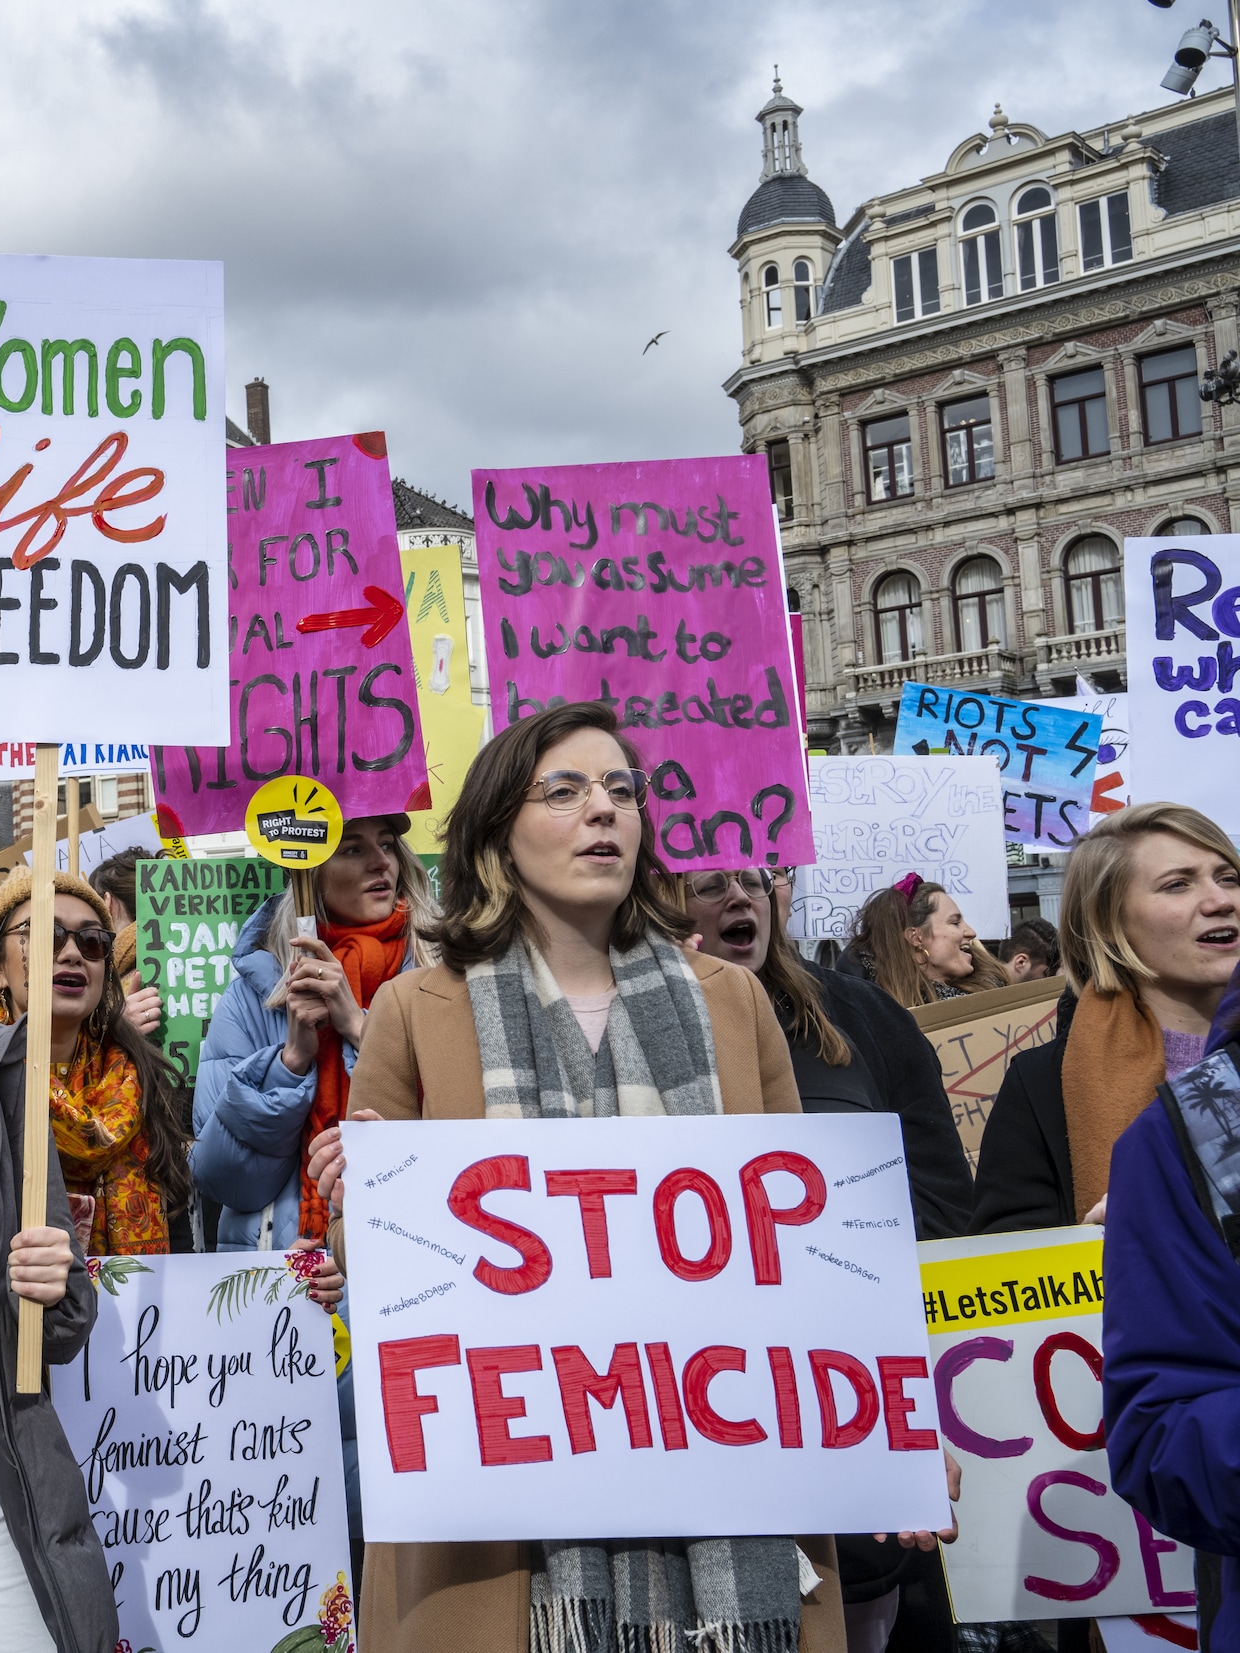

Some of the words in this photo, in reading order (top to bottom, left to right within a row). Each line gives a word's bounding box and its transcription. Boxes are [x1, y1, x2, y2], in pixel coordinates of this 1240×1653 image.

[226, 466, 267, 514] EN
[304, 457, 343, 509] I
[485, 481, 599, 550] Why
[609, 494, 744, 547] must
[259, 528, 359, 587] FOR
[497, 546, 586, 597] you
[590, 551, 767, 594] assume
[229, 611, 294, 656] AL
[500, 617, 520, 660] I
[530, 615, 667, 662] want
[675, 619, 732, 664] to
[155, 663, 415, 796] IGHTS
[507, 681, 568, 725] b
[916, 687, 1040, 741] RIOTS
[651, 759, 697, 801] a
[943, 729, 1049, 783] NOT
[262, 816, 292, 829] RIGHT
[268, 829, 279, 837] TO
[281, 826, 326, 838] PROTEST
[660, 783, 797, 866] an?
[1004, 791, 1083, 846] ETS
[140, 862, 290, 895] KANDIDAT
[149, 893, 278, 917] VERKIEZ
[813, 865, 883, 895] NOT
[142, 919, 164, 951] 1
[166, 920, 238, 953] JAN
[791, 895, 862, 938] PLa
[143, 956, 161, 990] 2
[167, 955, 239, 989] PET
[936, 1032, 974, 1078] CT
[993, 1021, 1057, 1076] YOU
[446, 1149, 828, 1296] STOP
[922, 1269, 1105, 1324] #LetsTalkAb
[120, 1304, 199, 1409] hope
[207, 1352, 255, 1408] you
[266, 1306, 326, 1384] like
[377, 1333, 940, 1475] FEMICIDE
[933, 1331, 1107, 1460] CO
[78, 1407, 209, 1505] feminist
[229, 1415, 312, 1461] rants
[176, 1478, 255, 1540] that's
[257, 1473, 320, 1533] kind
[1023, 1469, 1197, 1607] SE
[155, 1567, 207, 1638] my
[217, 1543, 320, 1627] thing
